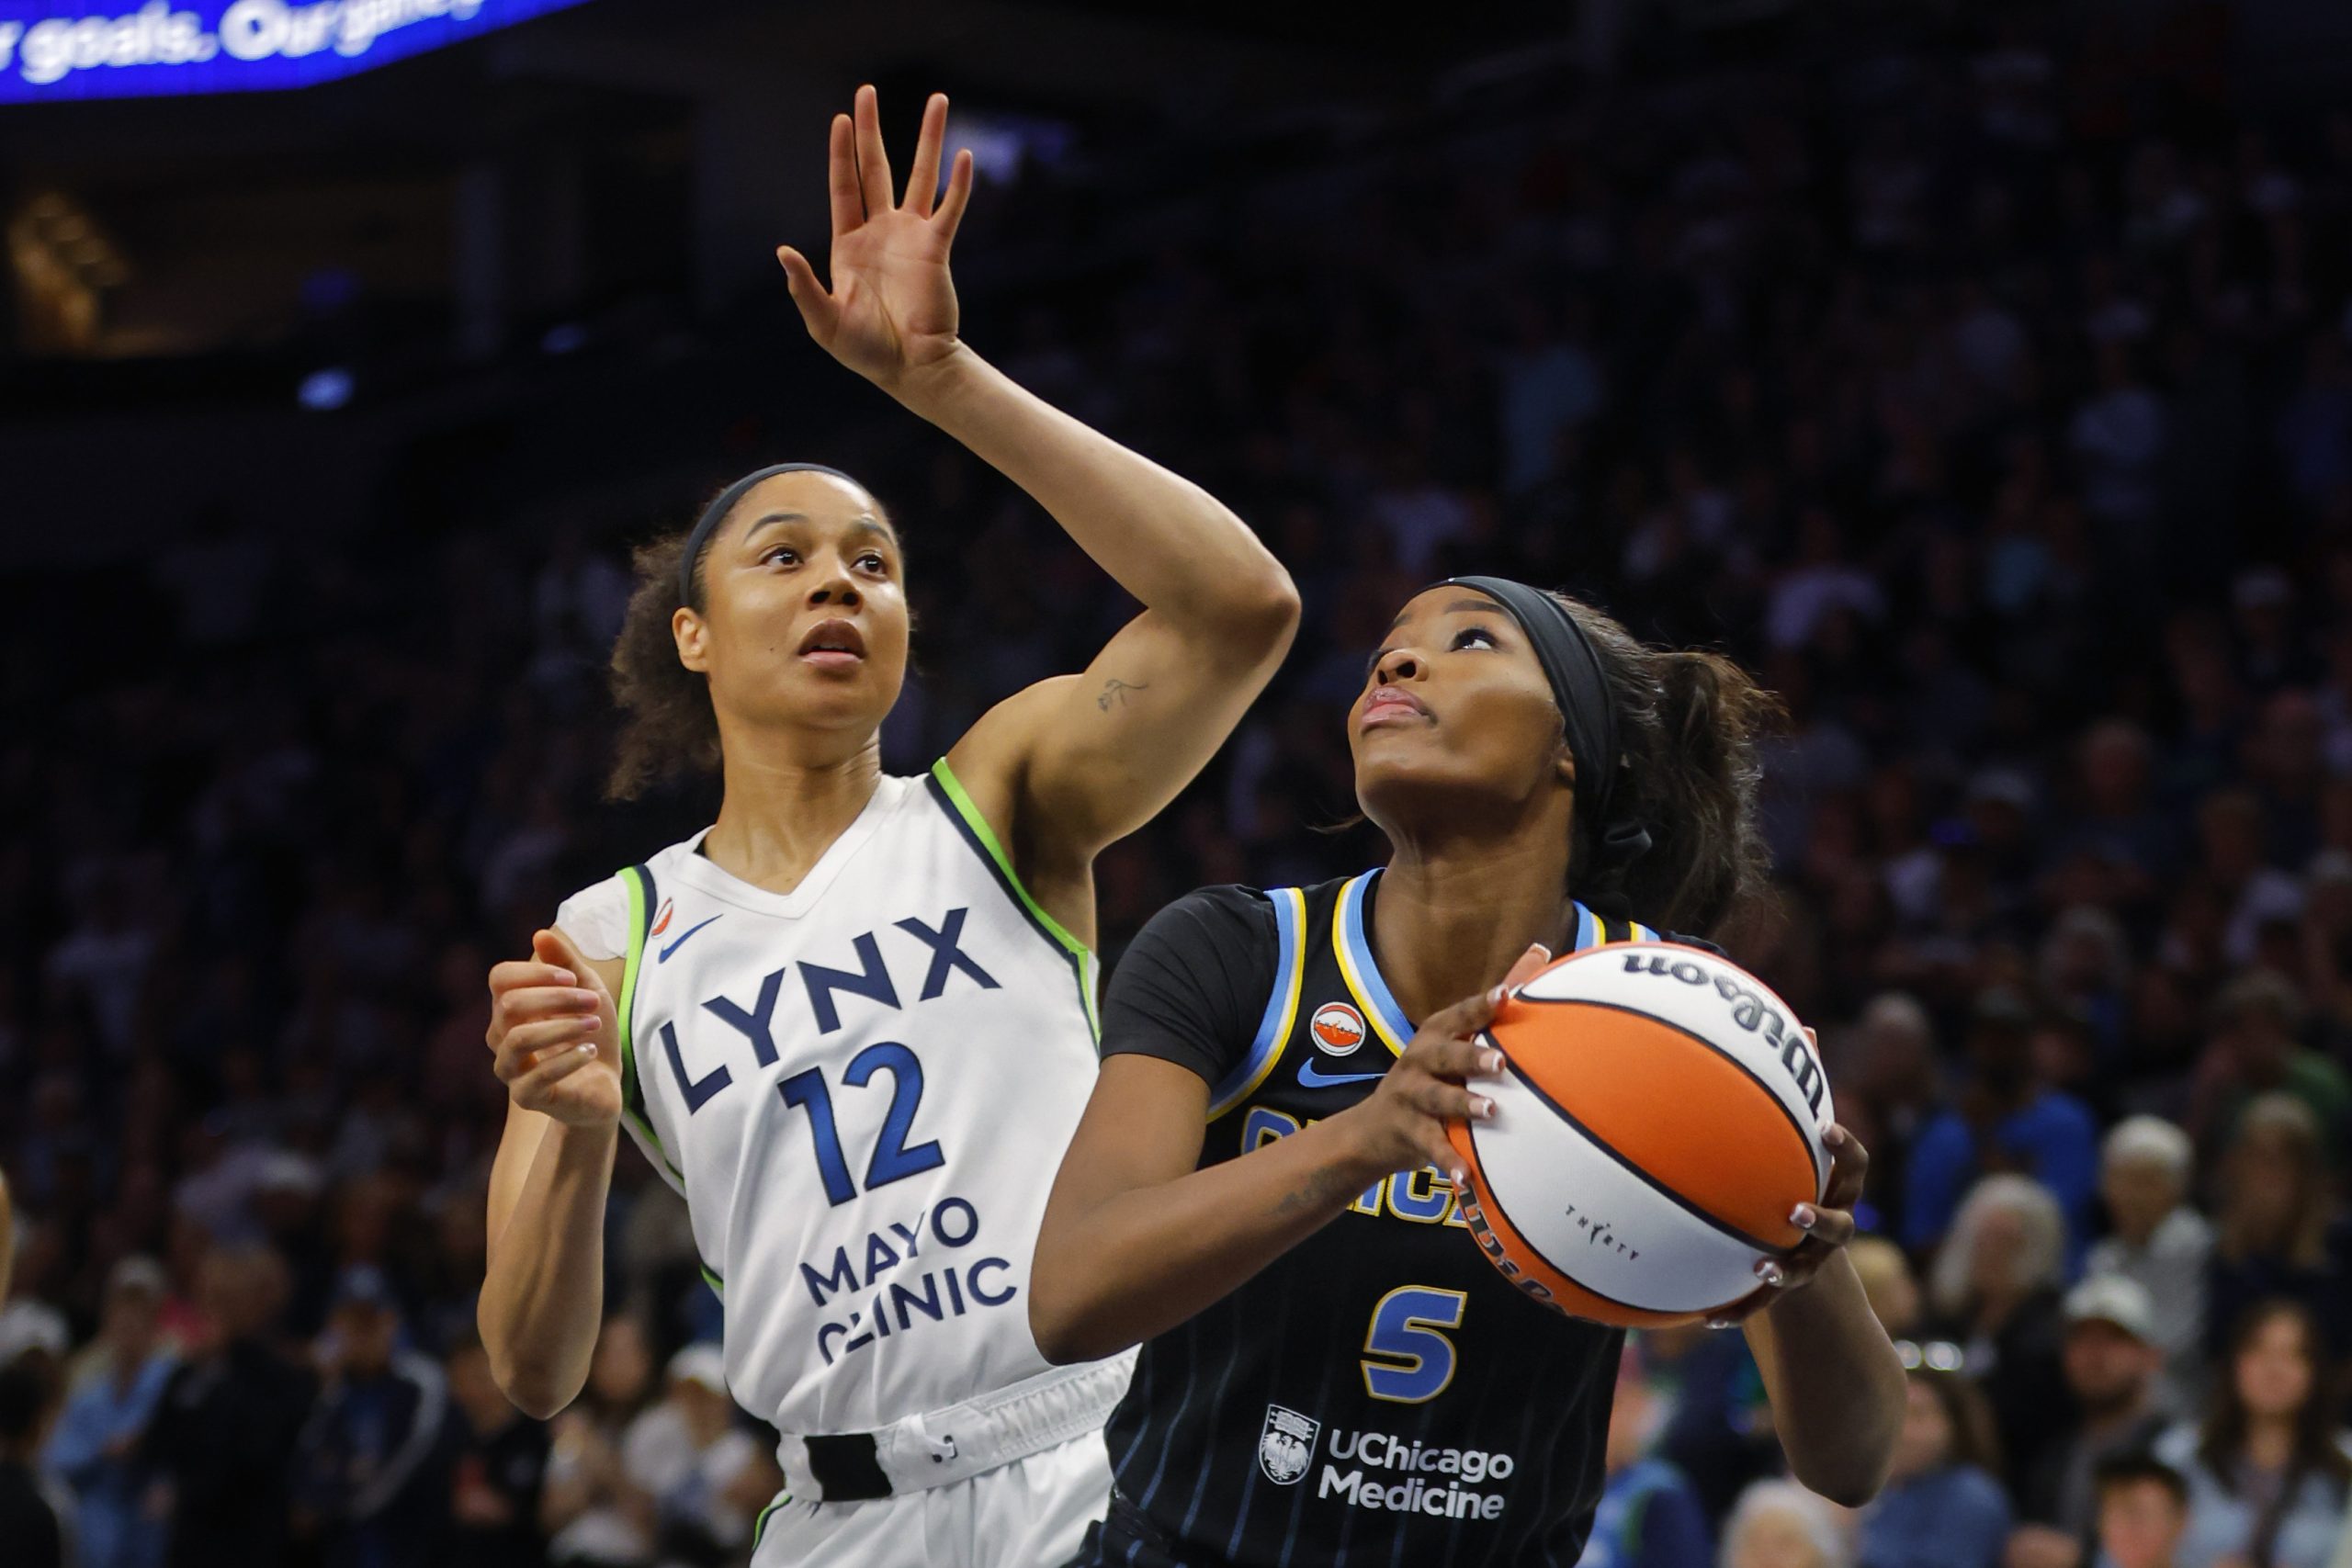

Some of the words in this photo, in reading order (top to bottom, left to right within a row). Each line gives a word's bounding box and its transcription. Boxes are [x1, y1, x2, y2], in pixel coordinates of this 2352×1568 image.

[659, 908, 1003, 1116] LYNX
[1623, 953, 1824, 1124] Wilson
[776, 1041, 945, 1207] 12
[799, 1197, 978, 1307] MAYO
[817, 1256, 1017, 1367] CLINIC
[1361, 1284, 1468, 1404] 5
[1317, 1464, 1505, 1520] Medicine
[1329, 1428, 1514, 1483] UChicago
